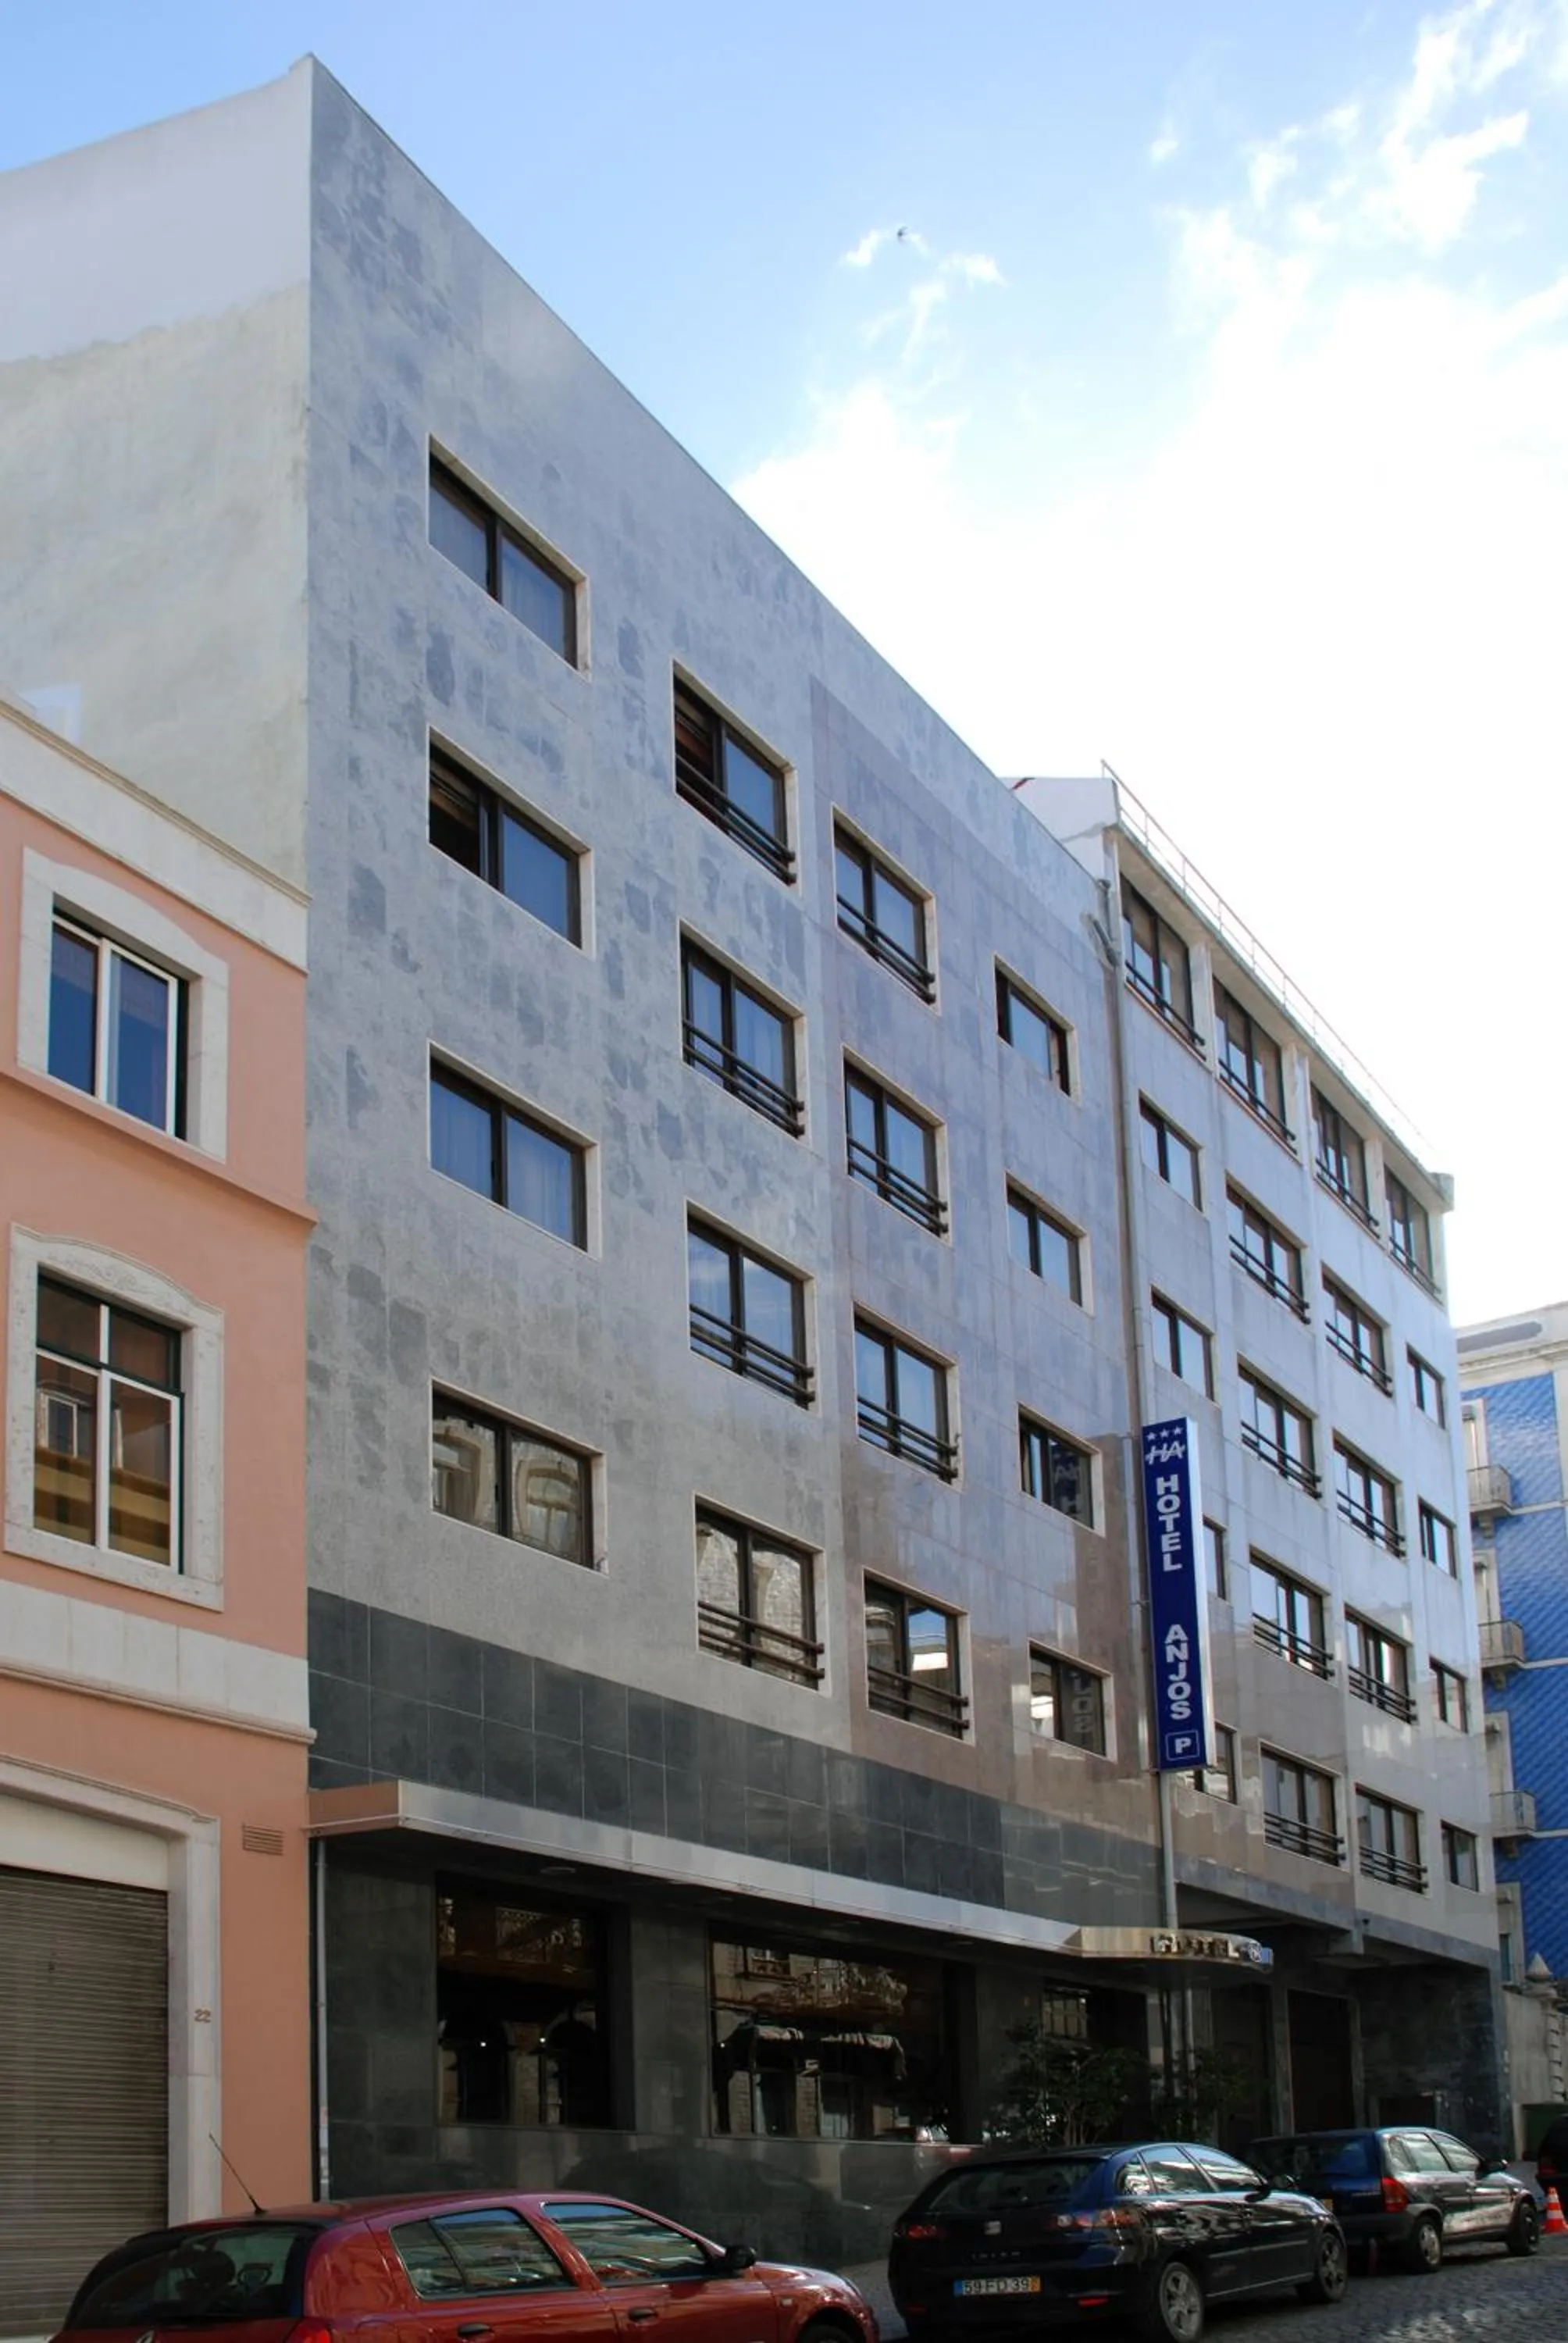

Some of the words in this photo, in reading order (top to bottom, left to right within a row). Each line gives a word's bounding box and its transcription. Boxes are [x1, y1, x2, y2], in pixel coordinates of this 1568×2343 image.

[1156, 1474, 1182, 1571] HOTEL
[1165, 1624, 1192, 1720] ANJOS
[1175, 1738, 1192, 1755] P
[194, 2009, 211, 2023] 22
